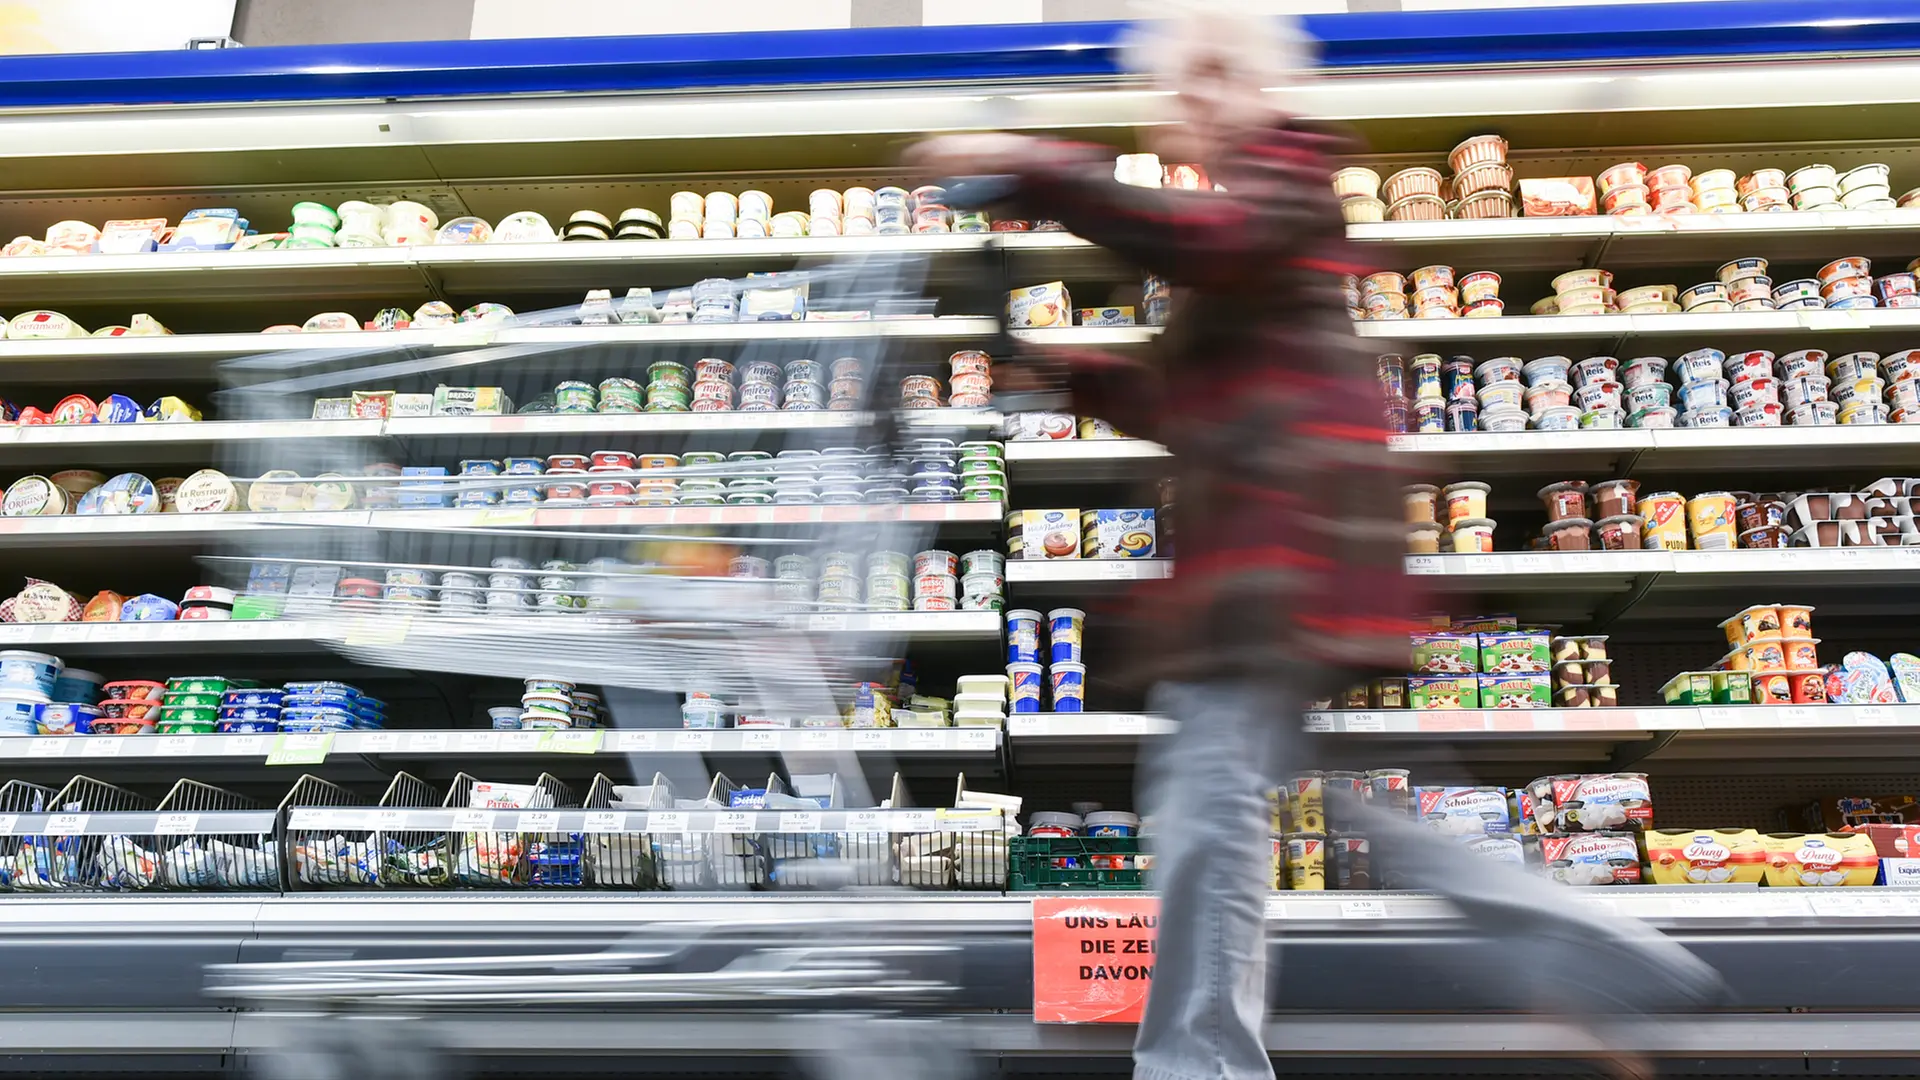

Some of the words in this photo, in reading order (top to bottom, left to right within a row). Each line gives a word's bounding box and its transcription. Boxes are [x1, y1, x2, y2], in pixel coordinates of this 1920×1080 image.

[706, 364, 732, 375] miree
[1692, 360, 1712, 369] Reis
[1786, 362, 1805, 372] Reis
[1887, 362, 1908, 373] Reis
[753, 366, 778, 377] miree
[1586, 367, 1604, 376] Reis
[703, 383, 730, 394] miree
[905, 378, 932, 391] miree
[1810, 384, 1826, 394] Reis
[447, 391, 476, 400] BRESSO
[744, 385, 770, 396] miree
[1736, 391, 1752, 401] Reis
[1837, 390, 1855, 401] Reis
[1584, 393, 1602, 402] Reis
[1635, 392, 1654, 402] Reis
[1699, 415, 1718, 424] Reis
[1744, 412, 1764, 424] Reis
[190, 487, 228, 498] RUSTIQUE
[1430, 641, 1461, 651] PAULA
[1501, 640, 1533, 651] PAULA
[1428, 681, 1460, 692] PAULA
[1500, 680, 1532, 691] PAULA
[272, 752, 296, 762] BIO
[1581, 784, 1618, 796] Schoko
[486, 800, 520, 809] PATROS
[1444, 796, 1479, 808] Schoko
[1570, 842, 1607, 855] Schoko
[1688, 846, 1724, 859] Dany
[1802, 849, 1836, 863] Dany
[1064, 915, 1108, 928] UNS
[1080, 940, 1116, 954] DIE
[1079, 966, 1153, 980] DAVON
